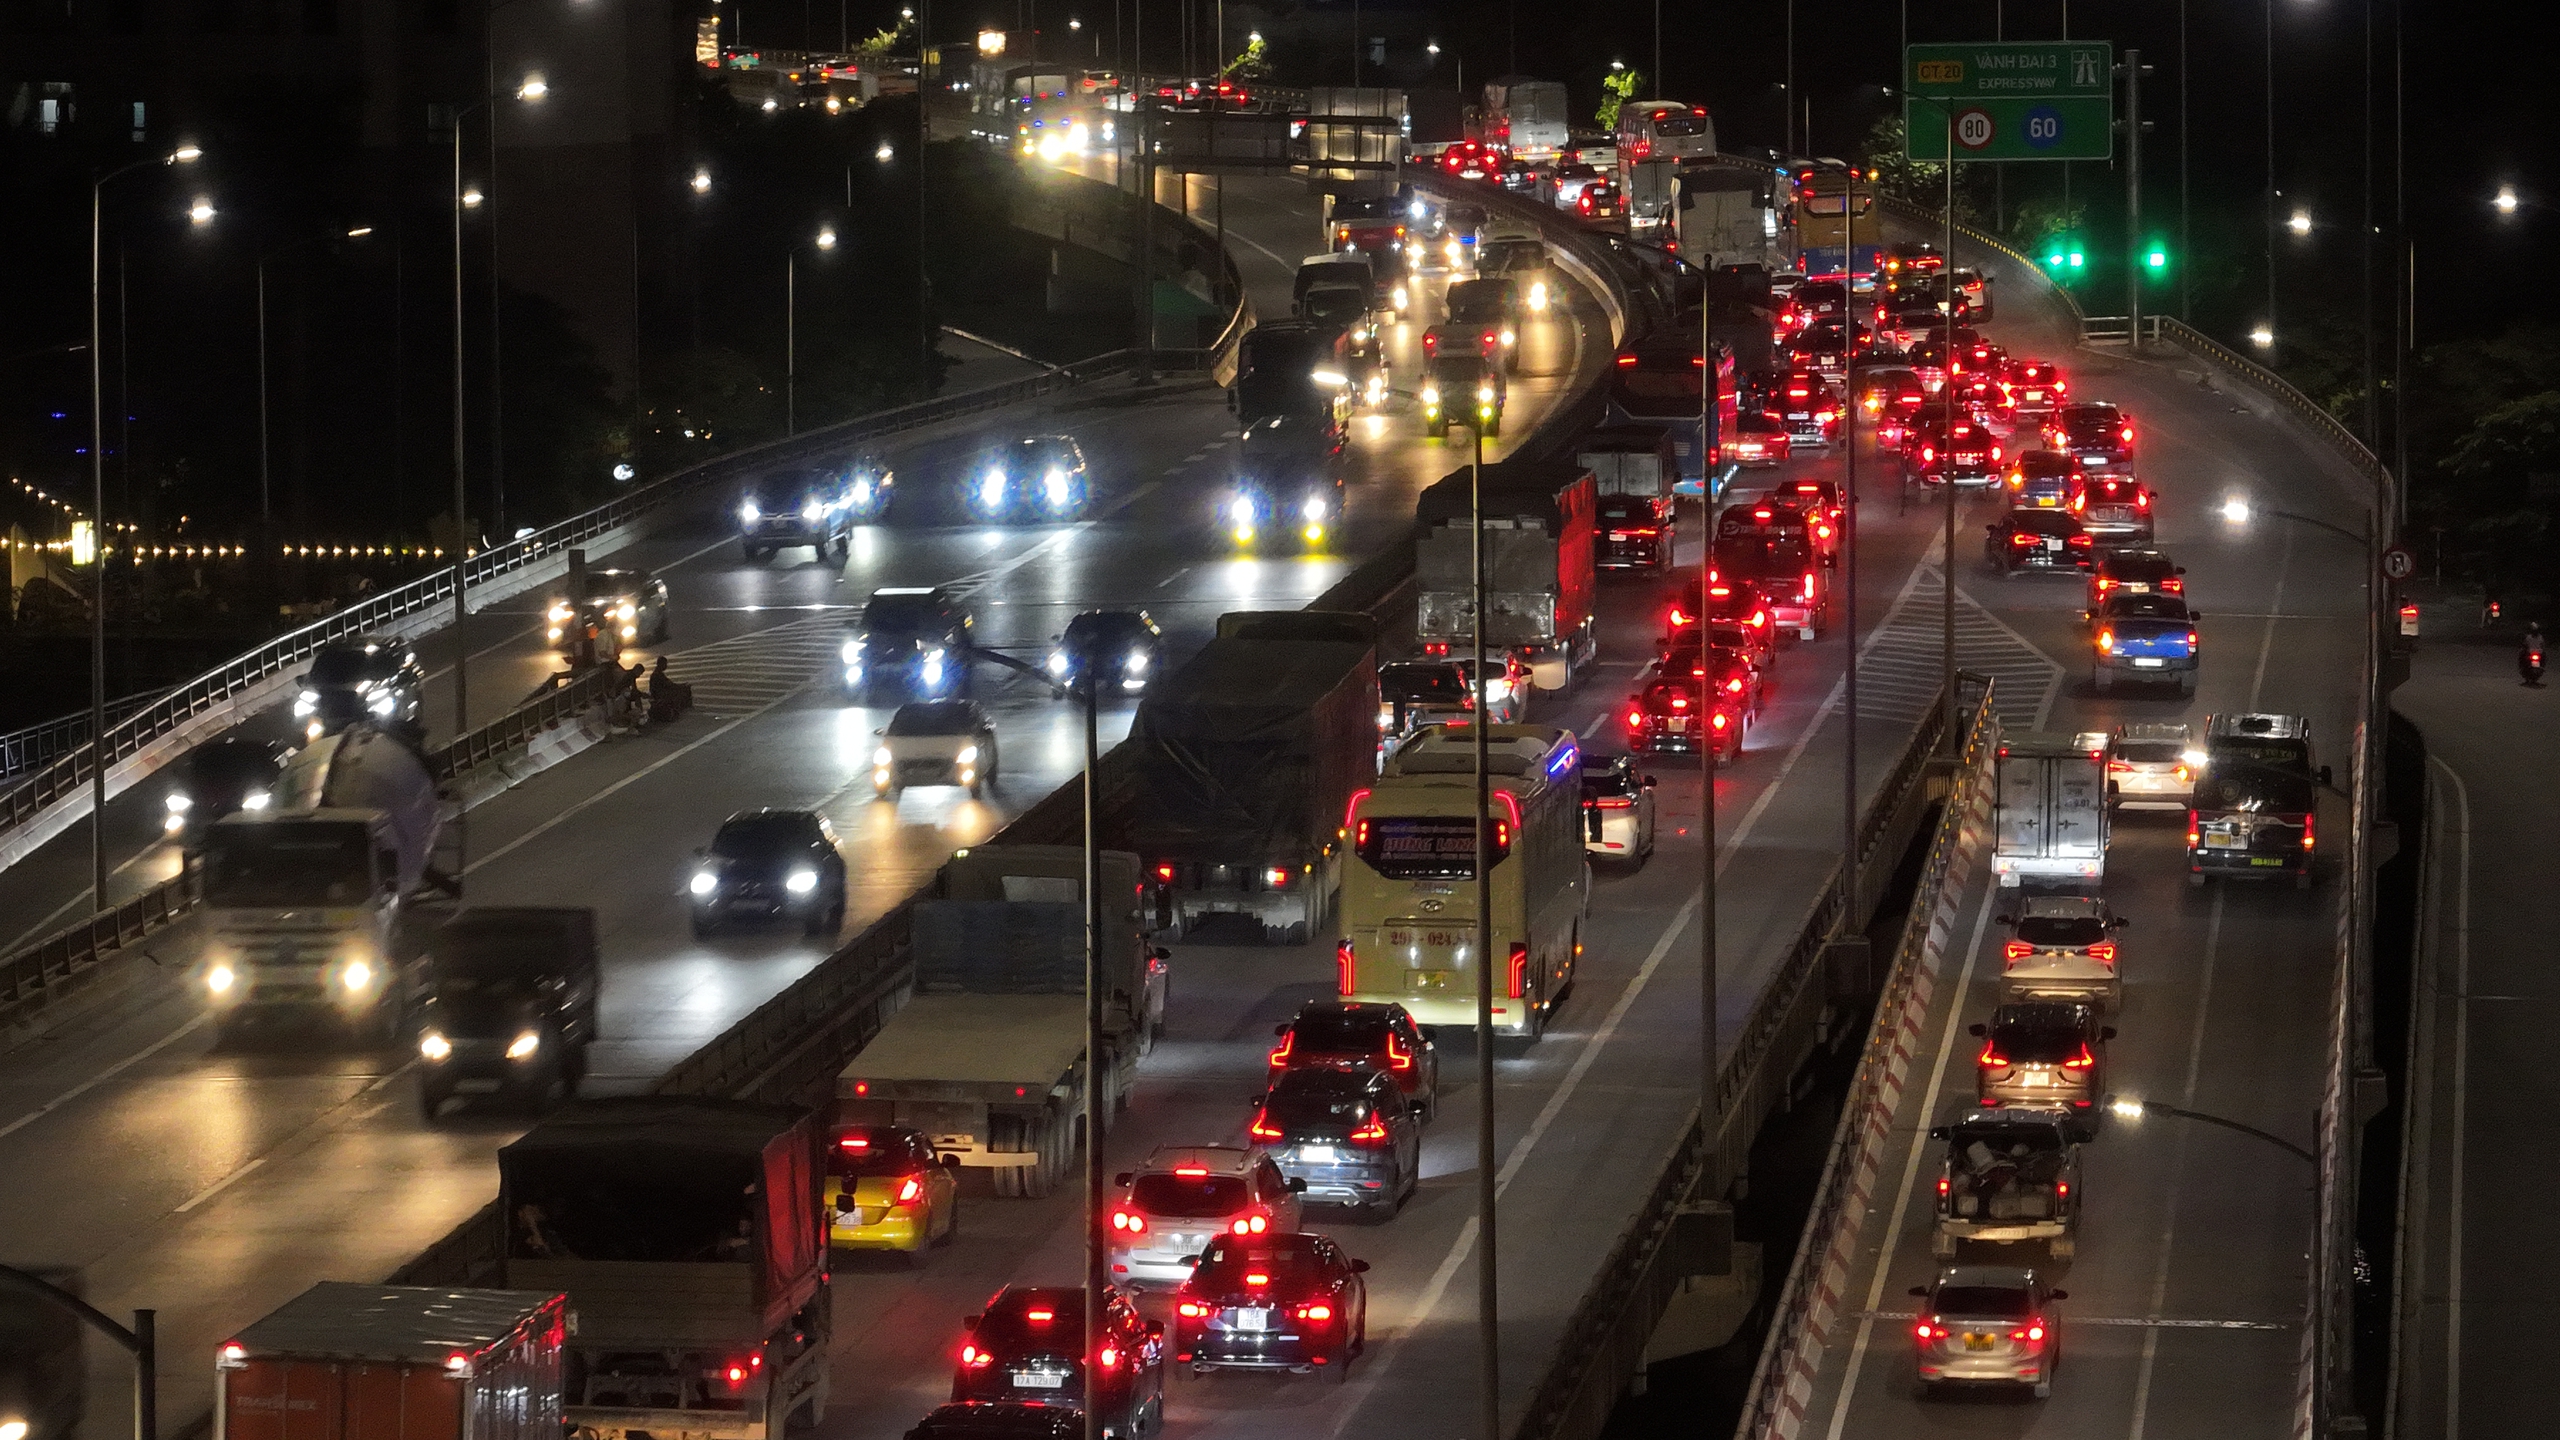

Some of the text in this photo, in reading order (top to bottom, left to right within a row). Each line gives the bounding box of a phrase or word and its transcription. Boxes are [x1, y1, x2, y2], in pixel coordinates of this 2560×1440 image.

[1975, 51, 2015, 69] VÀNH
[2049, 54, 2057, 68] 3
[1978, 77, 2057, 89] EXPRESSWAY
[1965, 119, 1984, 138] 80
[2030, 117, 2057, 138] 60
